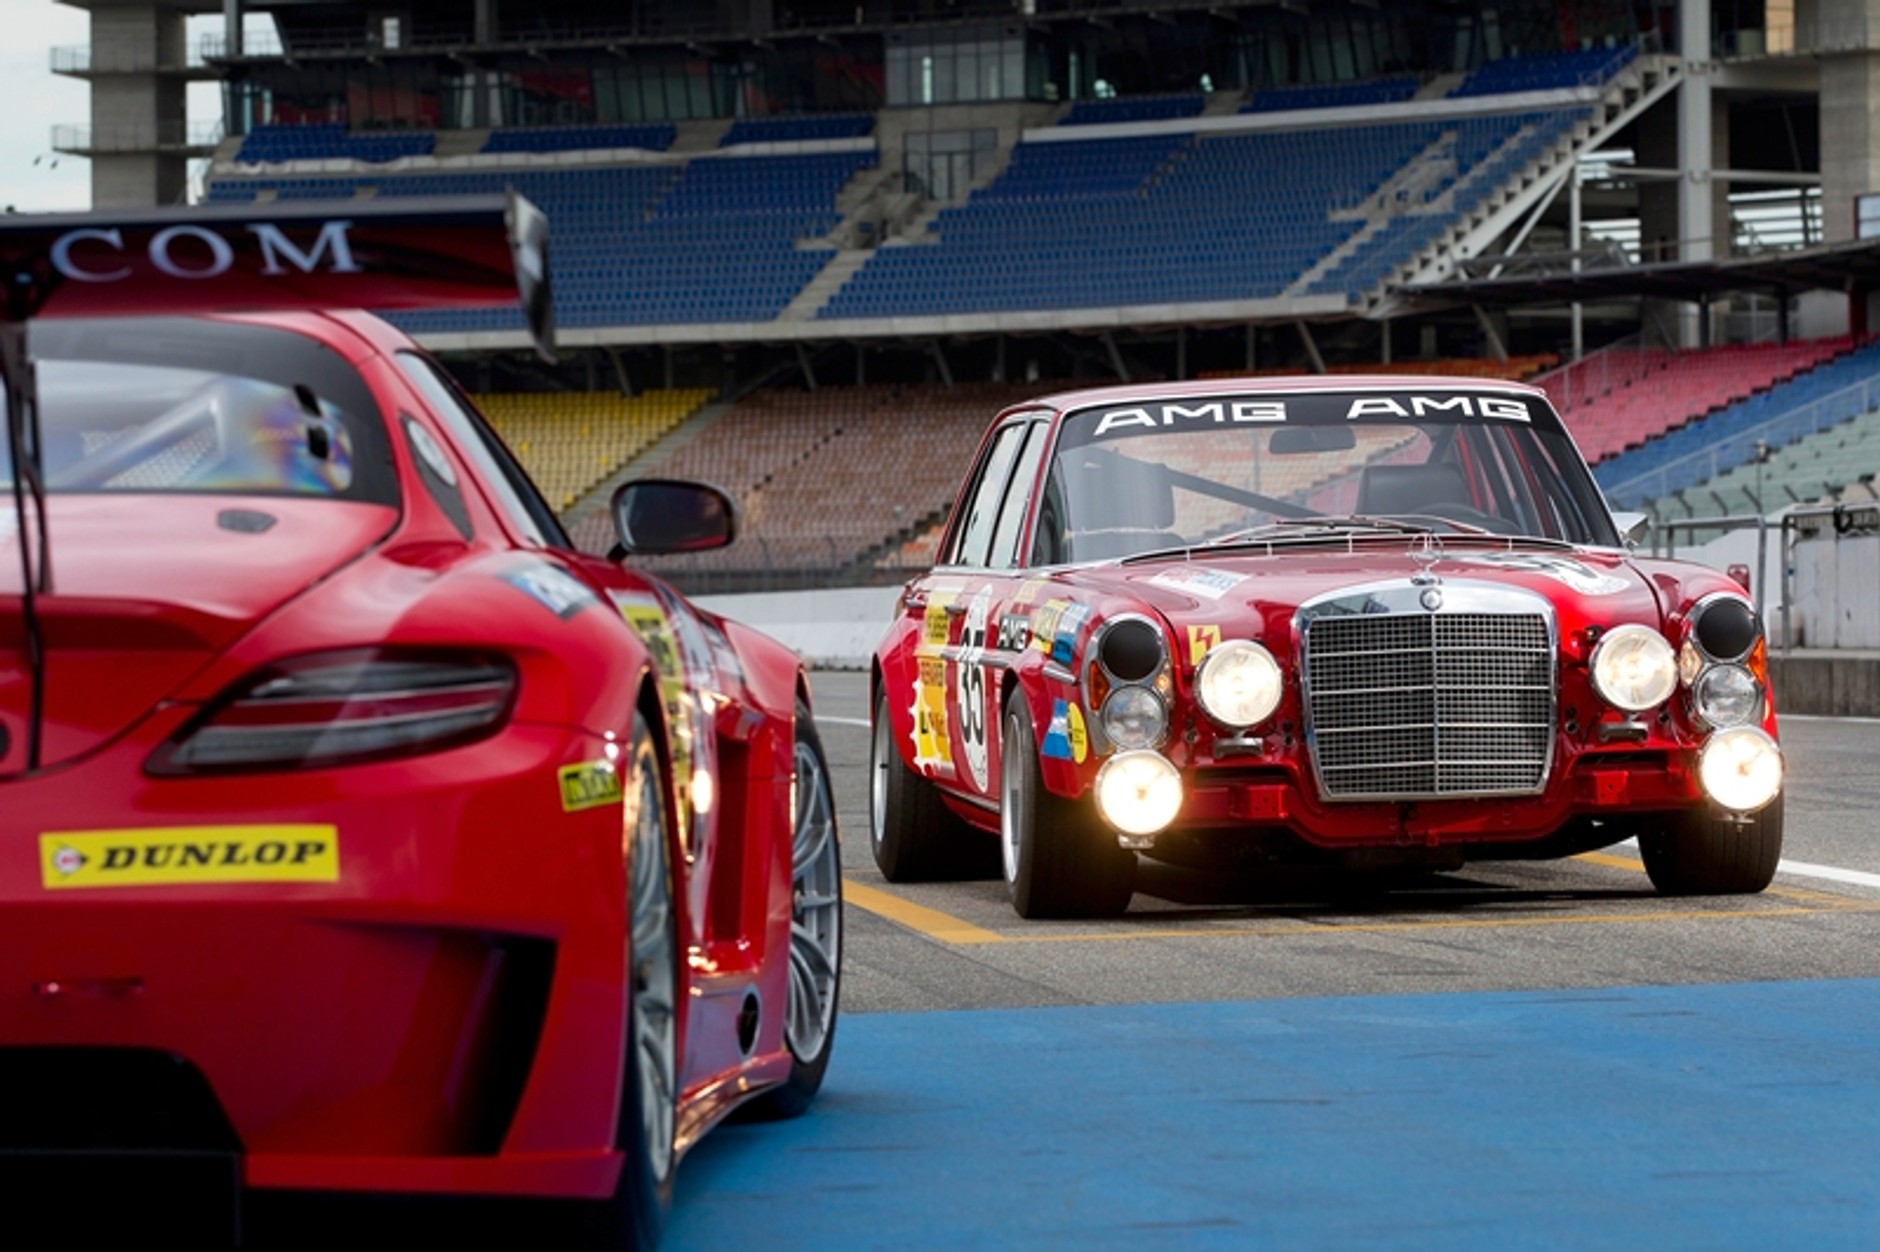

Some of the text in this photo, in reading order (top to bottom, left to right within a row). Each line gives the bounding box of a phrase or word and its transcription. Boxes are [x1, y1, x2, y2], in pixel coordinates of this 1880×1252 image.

[1094, 397, 1532, 436] AMG AMG
[99, 841, 327, 870] DUNLOP
